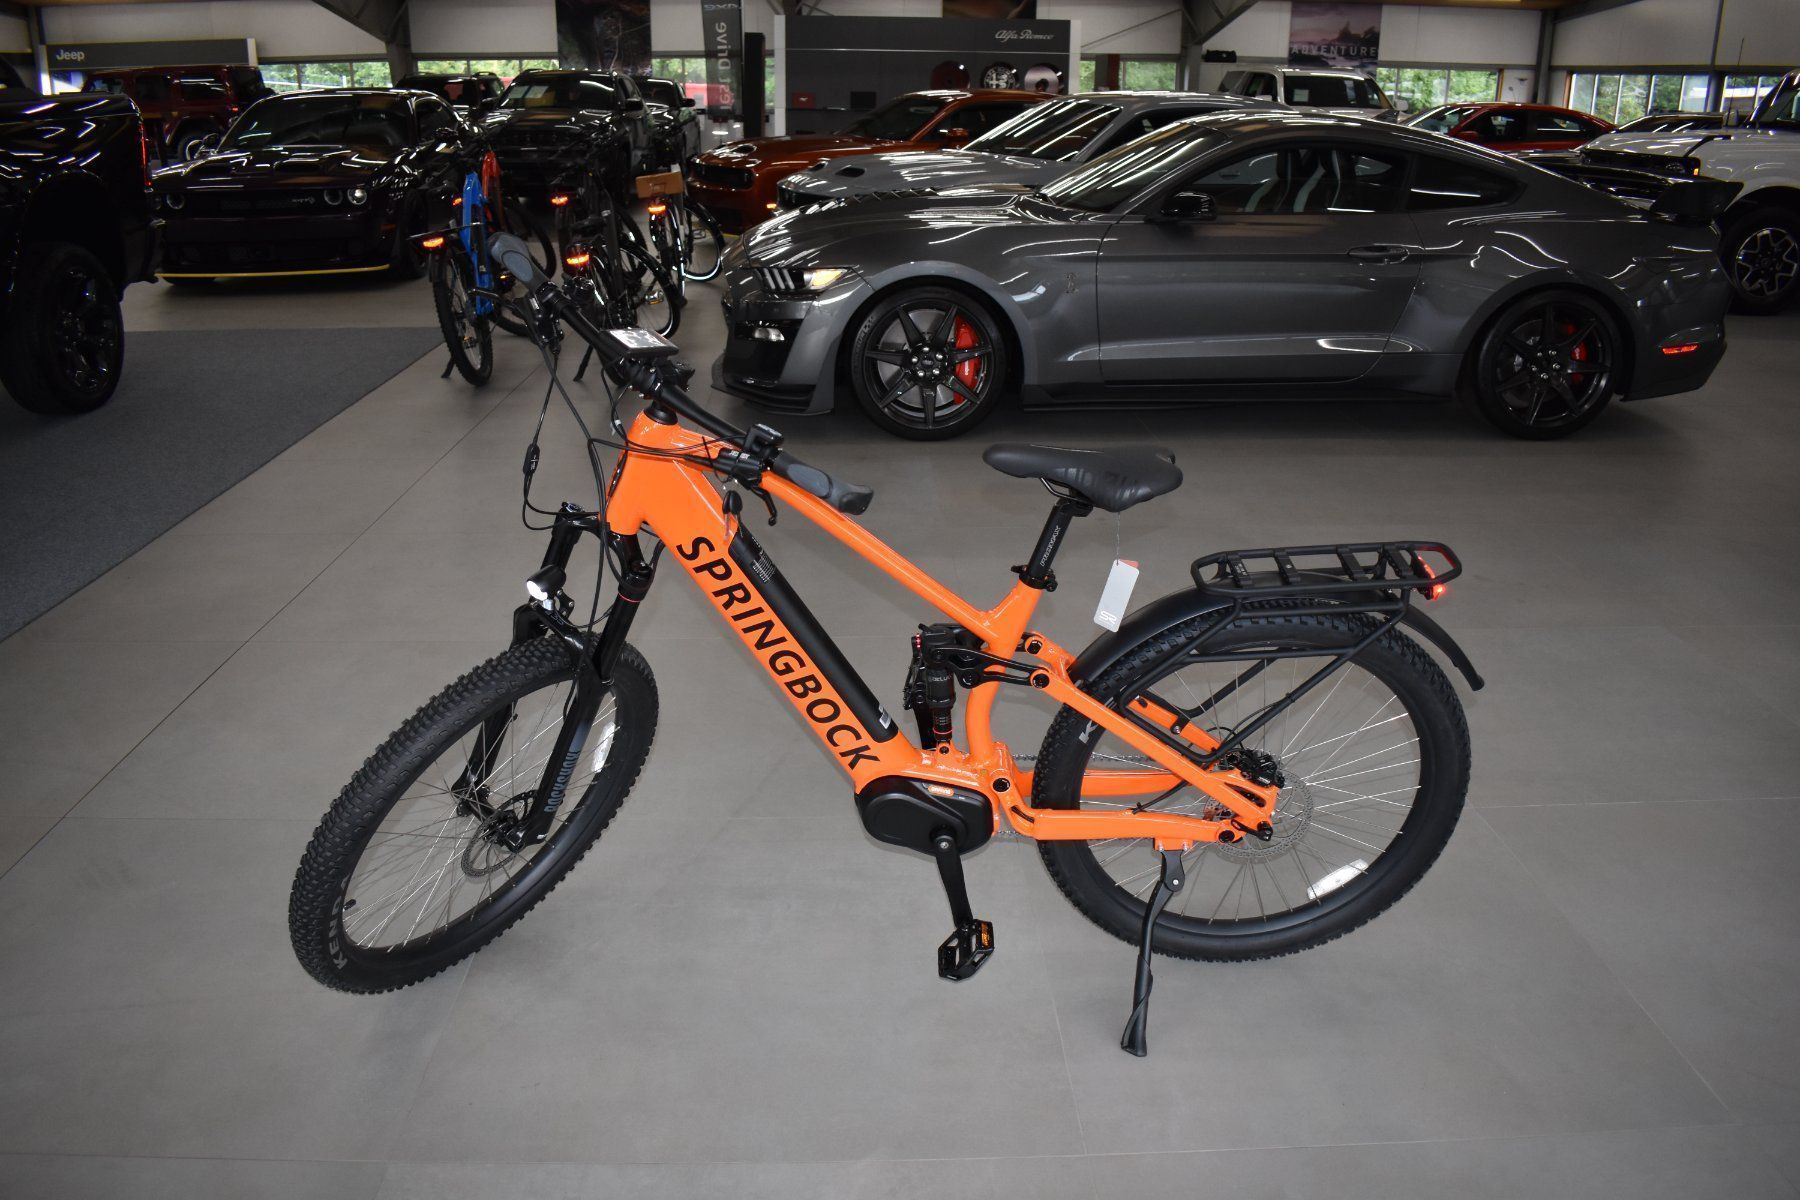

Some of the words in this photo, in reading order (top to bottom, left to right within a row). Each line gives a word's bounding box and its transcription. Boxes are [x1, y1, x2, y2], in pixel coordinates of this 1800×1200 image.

[995, 29, 1018, 42] Alfa
[56, 49, 85, 62] Jeep
[1291, 44, 1377, 57] ADVENTURE
[676, 536, 881, 771] SPRINGBOCK
